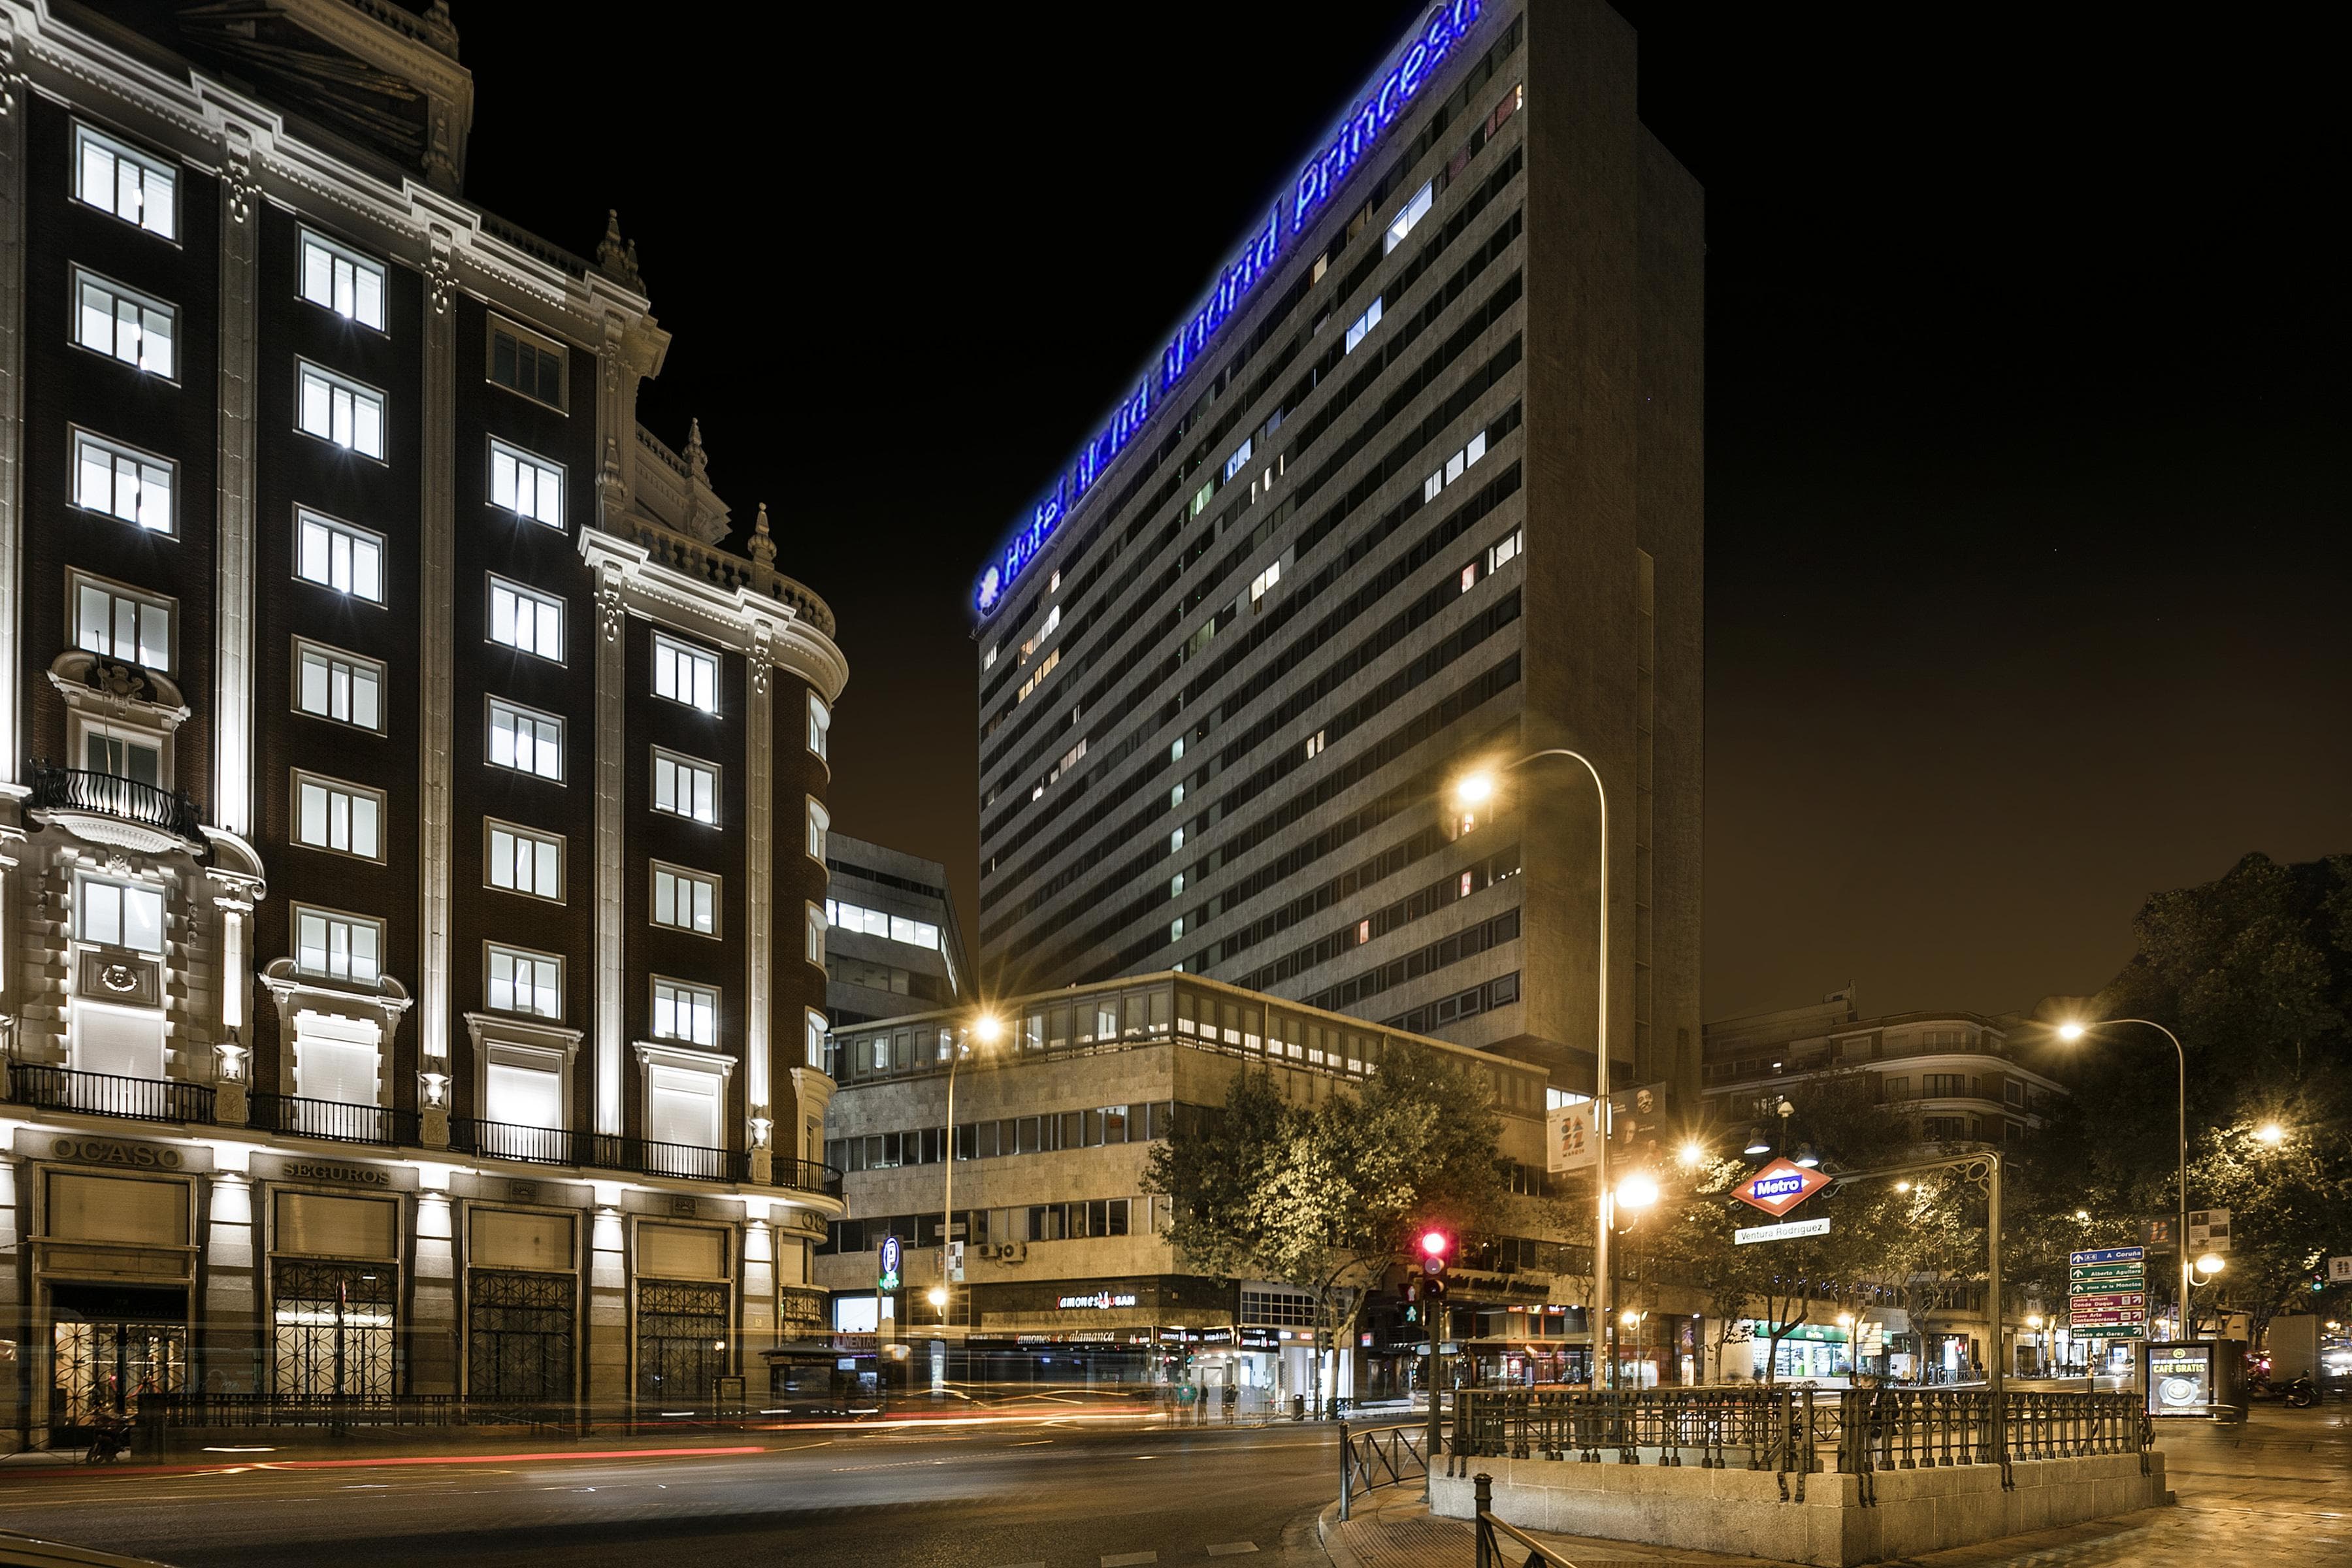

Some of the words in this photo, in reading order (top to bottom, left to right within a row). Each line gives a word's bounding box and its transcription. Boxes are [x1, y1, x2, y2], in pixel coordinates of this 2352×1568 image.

[50, 1137, 184, 1168] OCASO
[282, 1161, 392, 1186] SEGUROS
[1757, 1179, 1799, 1196] Metro
[1740, 1228, 1773, 1240] Ventura
[2153, 1364, 2174, 1373] CAFÉ
[2175, 1364, 2206, 1373] GRATIS
